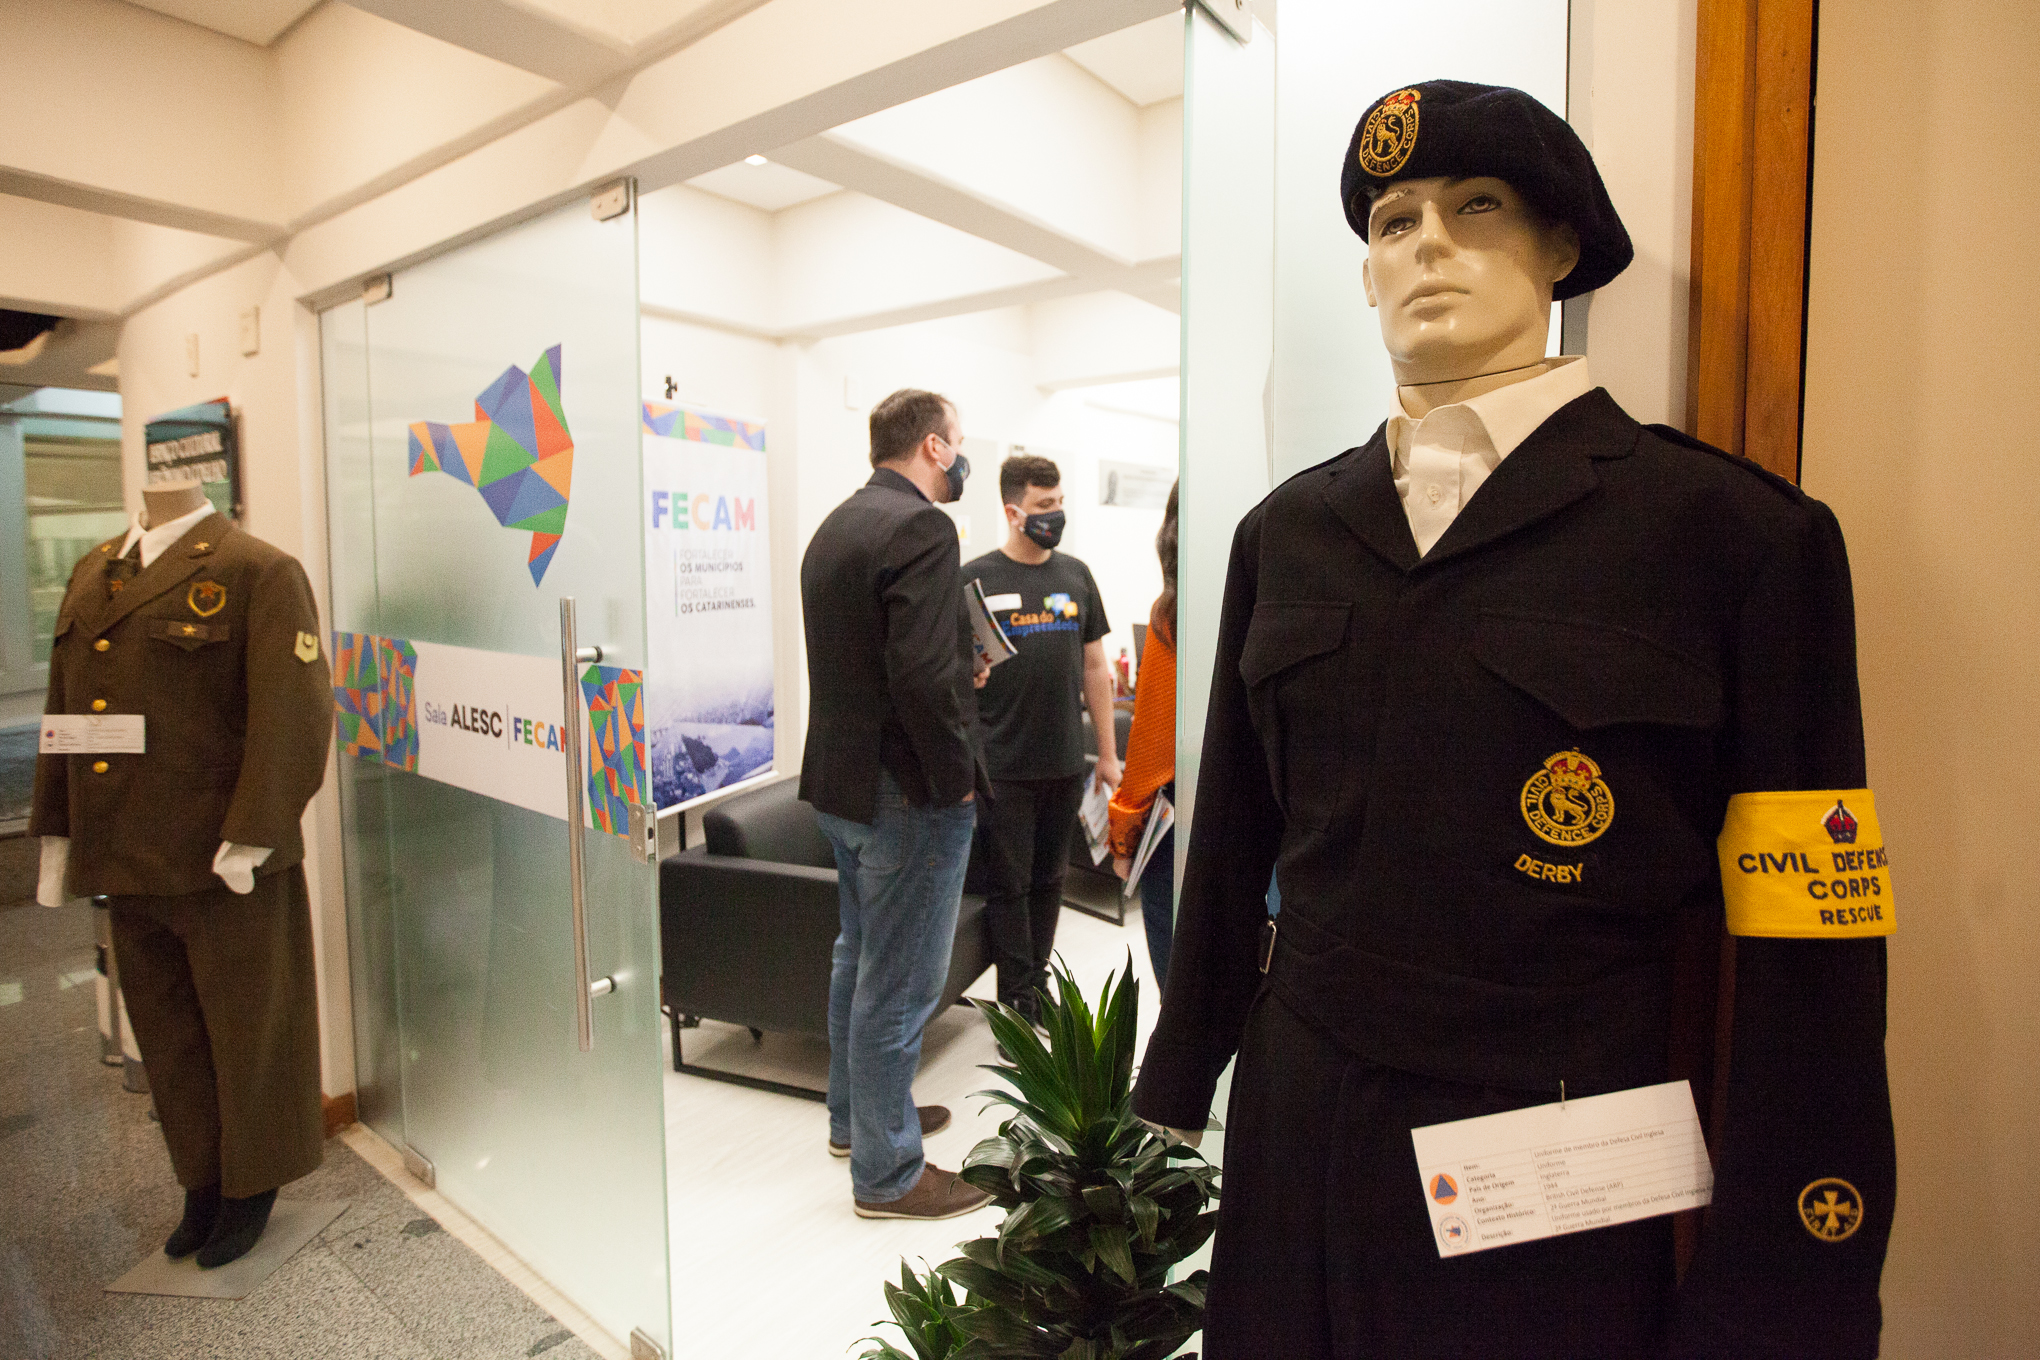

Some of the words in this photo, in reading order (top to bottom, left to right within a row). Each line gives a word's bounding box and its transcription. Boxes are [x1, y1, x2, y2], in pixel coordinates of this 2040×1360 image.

[1362, 148, 1404, 172] DEFENCE
[1403, 108, 1414, 149] CORPS
[652, 490, 755, 531] FECAM
[680, 562, 693, 573] OS
[680, 575, 703, 586] PARA
[680, 586, 734, 600] FORTALECER
[681, 602, 693, 614] OS
[1010, 612, 1039, 627] Casa
[1039, 610, 1054, 623] do
[424, 701, 447, 726] Sala
[450, 703, 503, 738] ALESC
[1526, 776, 1549, 807] CIVIL
[1590, 785, 1609, 828] CORPS
[1529, 810, 1594, 841] DEFENCE
[1514, 853, 1584, 884] DERBY
[1738, 852, 1819, 874] CIVIL
[1807, 876, 1881, 900] CORPS
[1819, 904, 1883, 926] RESCUE
[1534, 1148, 1562, 1157] Uniforme
[1573, 1141, 1600, 1151] membro
[1609, 1136, 1630, 1145] Defesa
[1630, 1133, 1643, 1141] Civil
[1643, 1129, 1664, 1138] Inglesa
[1537, 1160, 1566, 1169] Uniforme
[1539, 1170, 1570, 1180] Inglaterra
[1492, 1180, 1515, 1189] Origem
[1545, 1191, 1565, 1200] British
[1566, 1188, 1579, 1197] Civil
[1551, 1211, 1580, 1221] Uniforme
[1581, 1208, 1601, 1217] usado
[1601, 1206, 1612, 1215] por
[1613, 1200, 1642, 1211] membros
[1642, 1197, 1650, 1205] da
[1650, 1193, 1671, 1202] Defesa
[1558, 1200, 1580, 1210] Guerra
[1580, 1195, 1607, 1205] Mundial
[1562, 1221, 1584, 1231] Guerra
